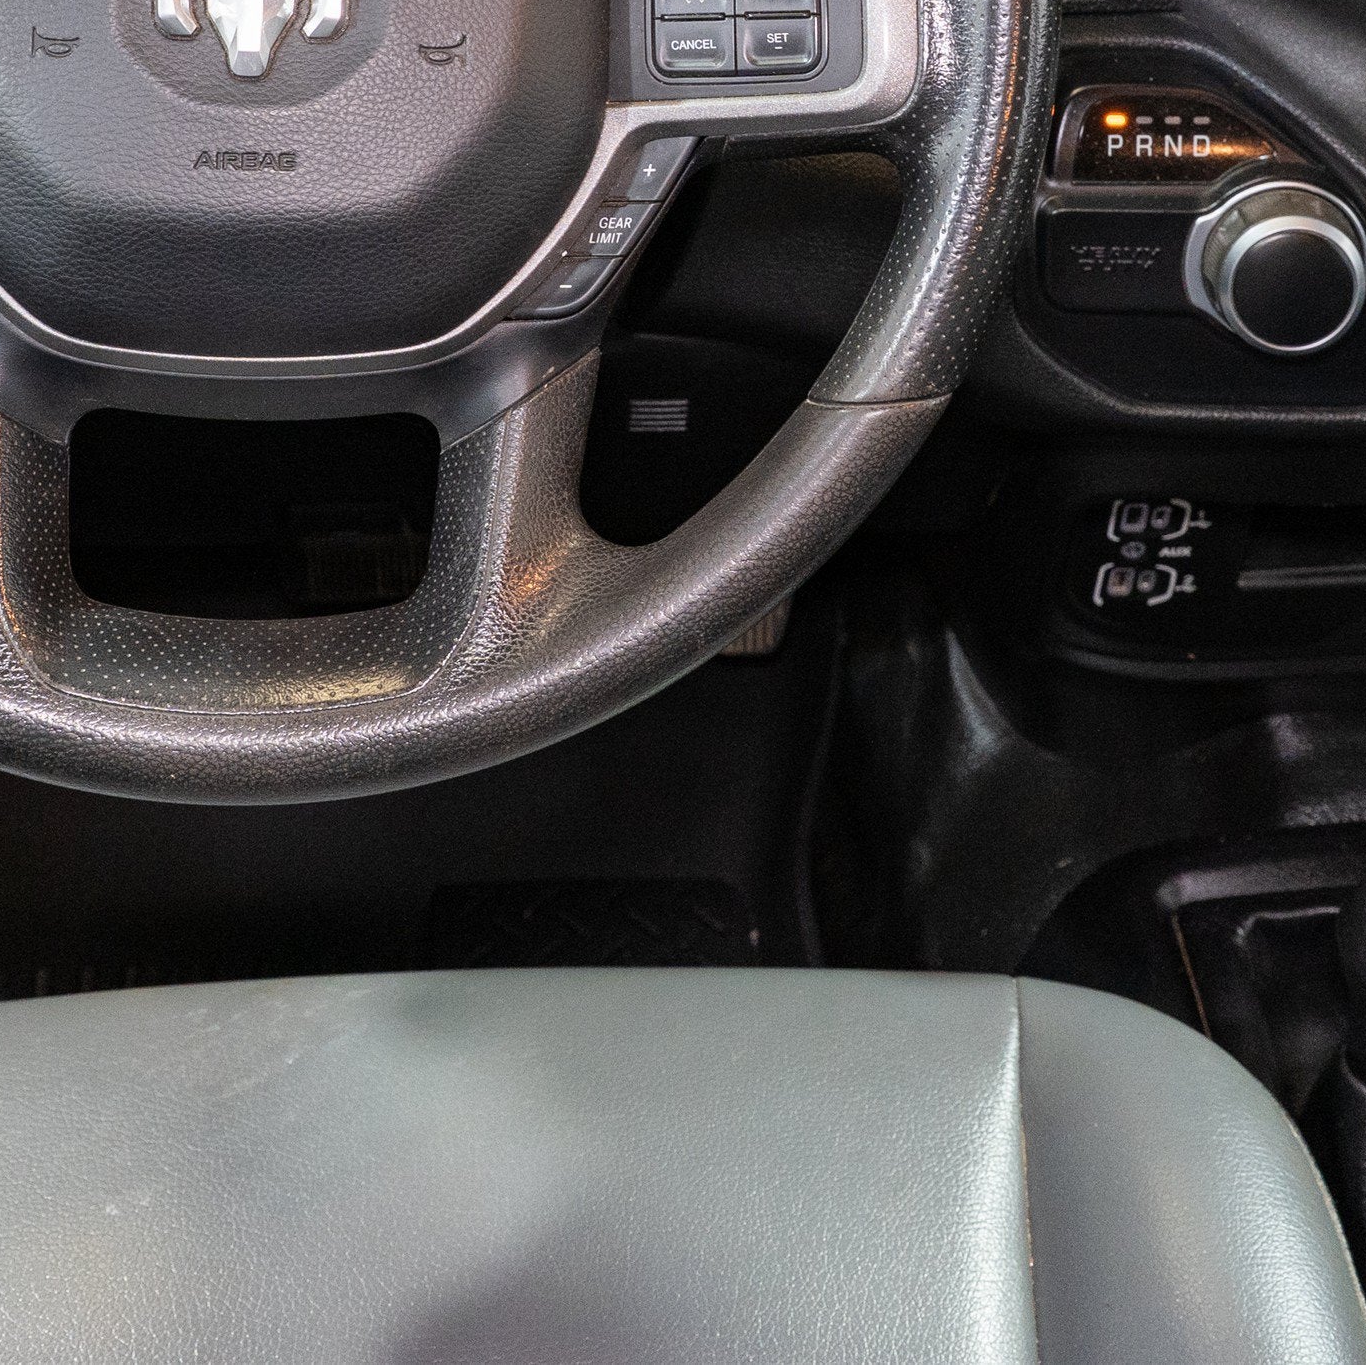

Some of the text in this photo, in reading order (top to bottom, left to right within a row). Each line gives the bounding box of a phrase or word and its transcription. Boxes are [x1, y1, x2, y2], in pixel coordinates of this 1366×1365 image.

[766, 32, 789, 43] SET
[671, 39, 717, 51] CANCEL
[1107, 134, 1211, 157] P R N D
[192, 150, 297, 172] AIRBAG
[598, 217, 633, 229] GEAR
[588, 232, 623, 244] LIMIT
[1158, 546, 1192, 558] AUX
